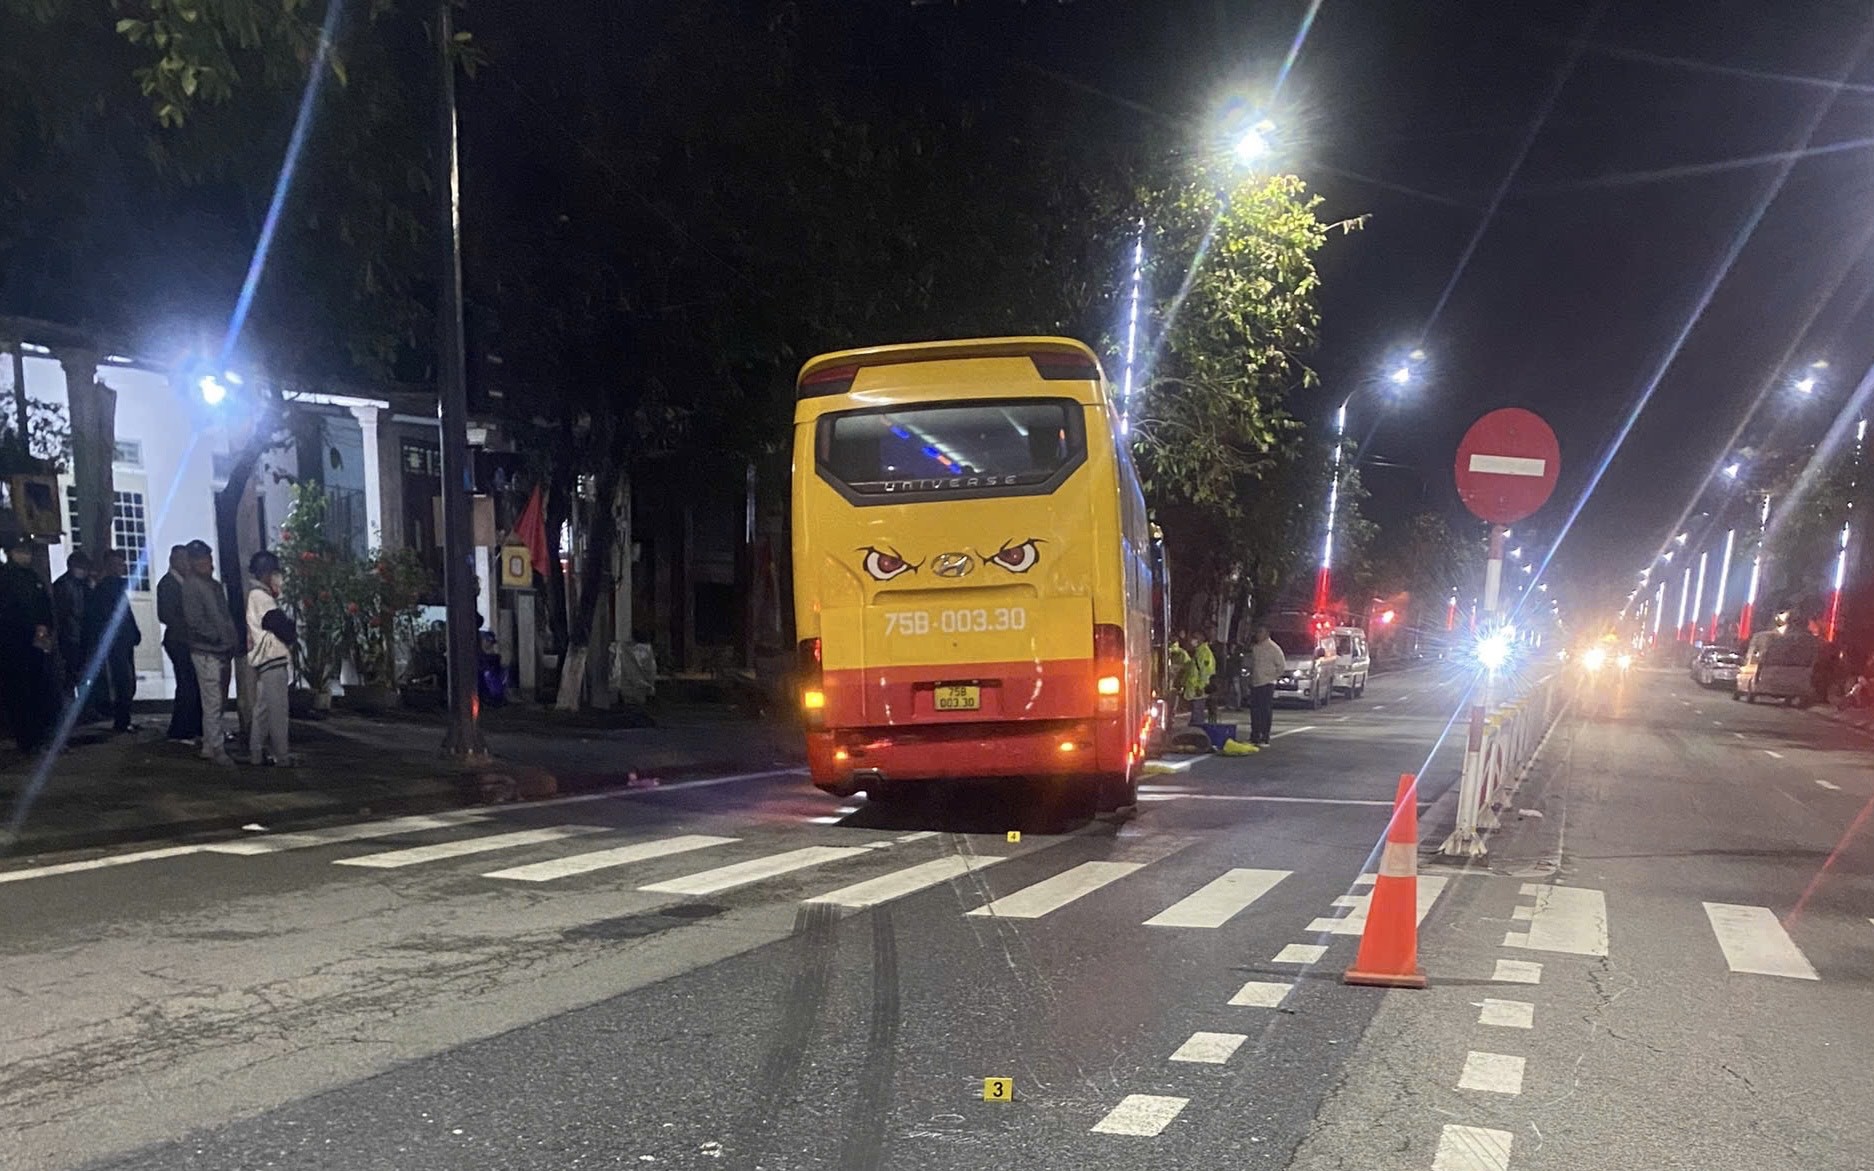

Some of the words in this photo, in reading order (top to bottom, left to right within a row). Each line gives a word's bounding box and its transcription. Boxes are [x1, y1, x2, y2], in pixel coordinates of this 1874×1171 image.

[884, 475, 1017, 491] UNIVERSE
[949, 687, 967, 697] 75B
[993, 1081, 1003, 1097] 3
